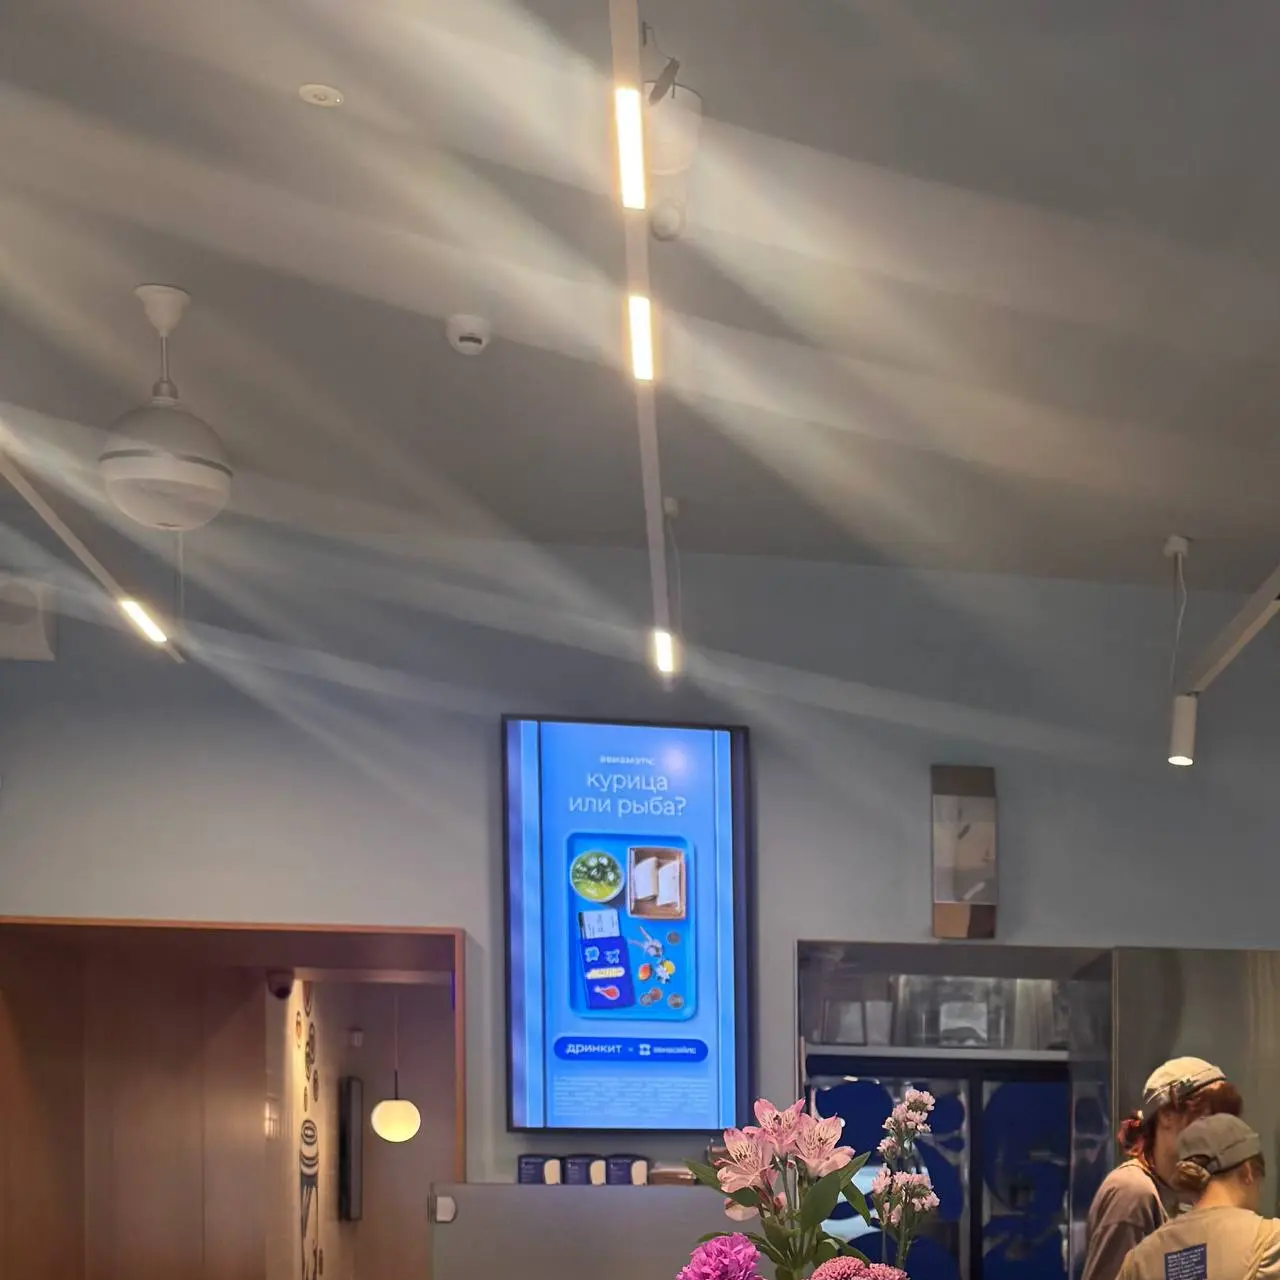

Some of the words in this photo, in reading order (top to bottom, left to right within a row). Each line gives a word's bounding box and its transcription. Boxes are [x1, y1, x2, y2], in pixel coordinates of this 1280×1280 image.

[587, 773, 668, 794] курица
[569, 797, 611, 812] или
[618, 796, 687, 817] рыба?
